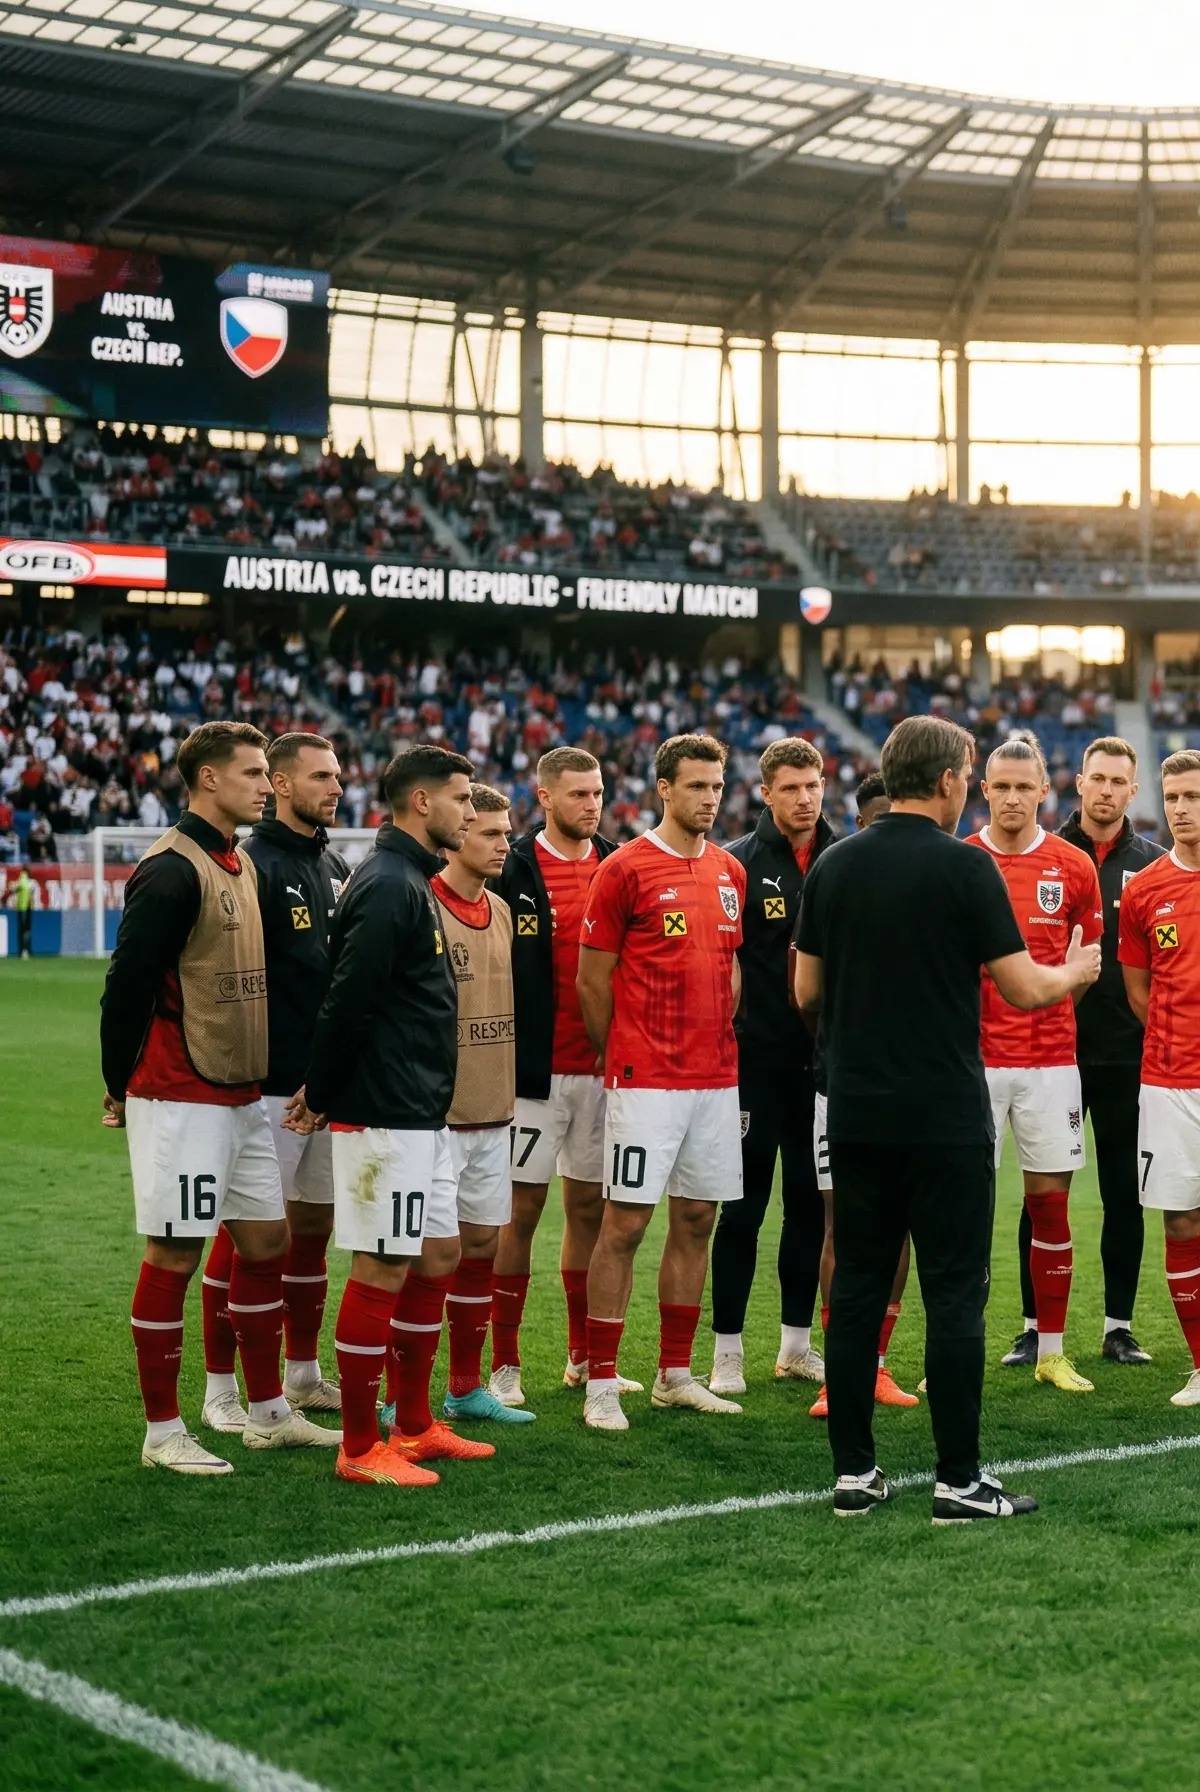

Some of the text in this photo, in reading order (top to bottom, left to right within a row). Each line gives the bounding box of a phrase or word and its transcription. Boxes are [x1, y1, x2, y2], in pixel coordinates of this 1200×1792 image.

[101, 292, 174, 322] AUSTRIA
[91, 336, 143, 364] CZECH
[224, 556, 329, 594] AUSTRIA
[333, 570, 366, 596] vs.
[371, 564, 445, 601] CZECH
[449, 570, 559, 607] REPUBLIC
[577, 577, 681, 614] FRIENDLY
[683, 583, 758, 618] MATCH
[613, 1143, 646, 1189] 10
[1141, 1151, 1154, 1192] 7
[179, 1174, 216, 1220] 16
[392, 1191, 424, 1239] 10
